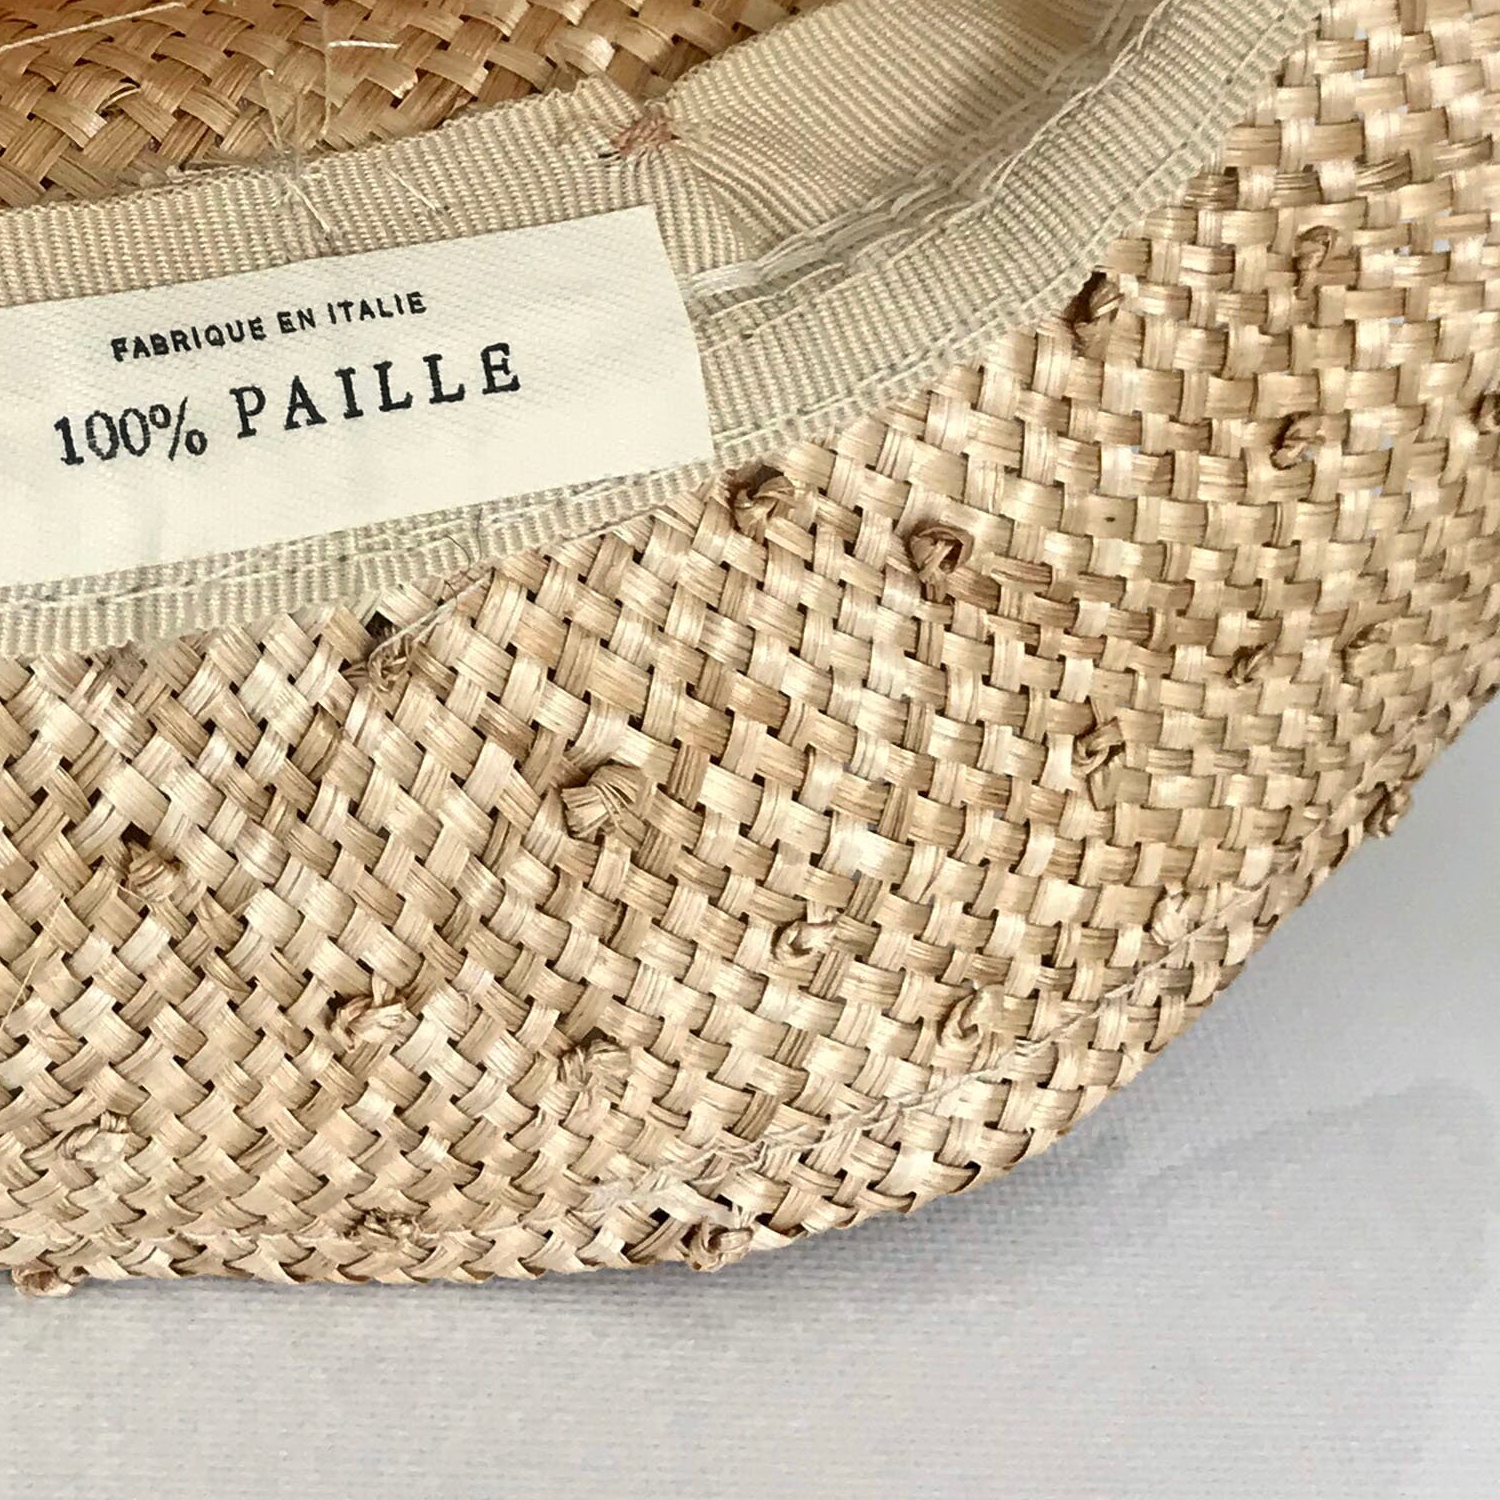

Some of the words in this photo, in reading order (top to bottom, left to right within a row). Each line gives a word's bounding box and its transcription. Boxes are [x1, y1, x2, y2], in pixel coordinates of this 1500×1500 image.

[110, 316, 267, 363] FABRIQUE
[276, 307, 317, 334] EN
[327, 291, 427, 325] ITALIE
[53, 396, 208, 466] 100%
[229, 342, 521, 440] PAILLE
